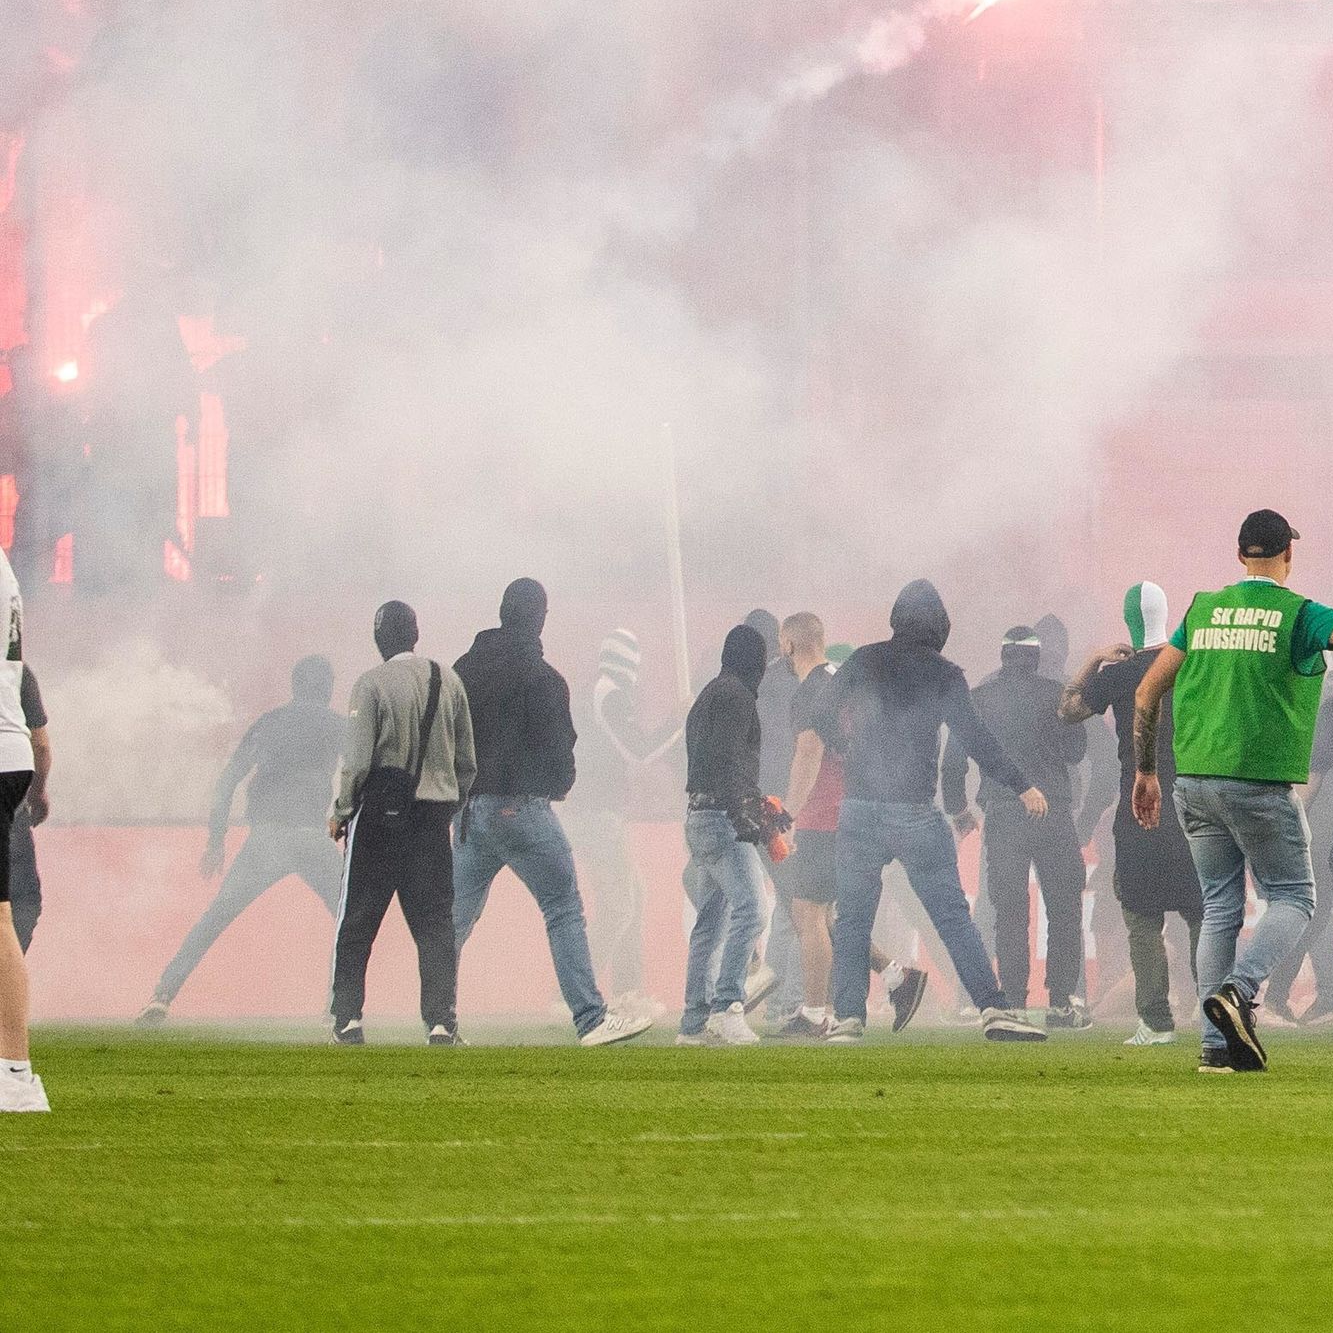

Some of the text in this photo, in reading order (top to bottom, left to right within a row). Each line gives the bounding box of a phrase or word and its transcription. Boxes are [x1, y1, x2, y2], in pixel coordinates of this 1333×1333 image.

[1211, 607, 1283, 628] SK RAPID
[1191, 627, 1278, 653] KLUBSERVICE
